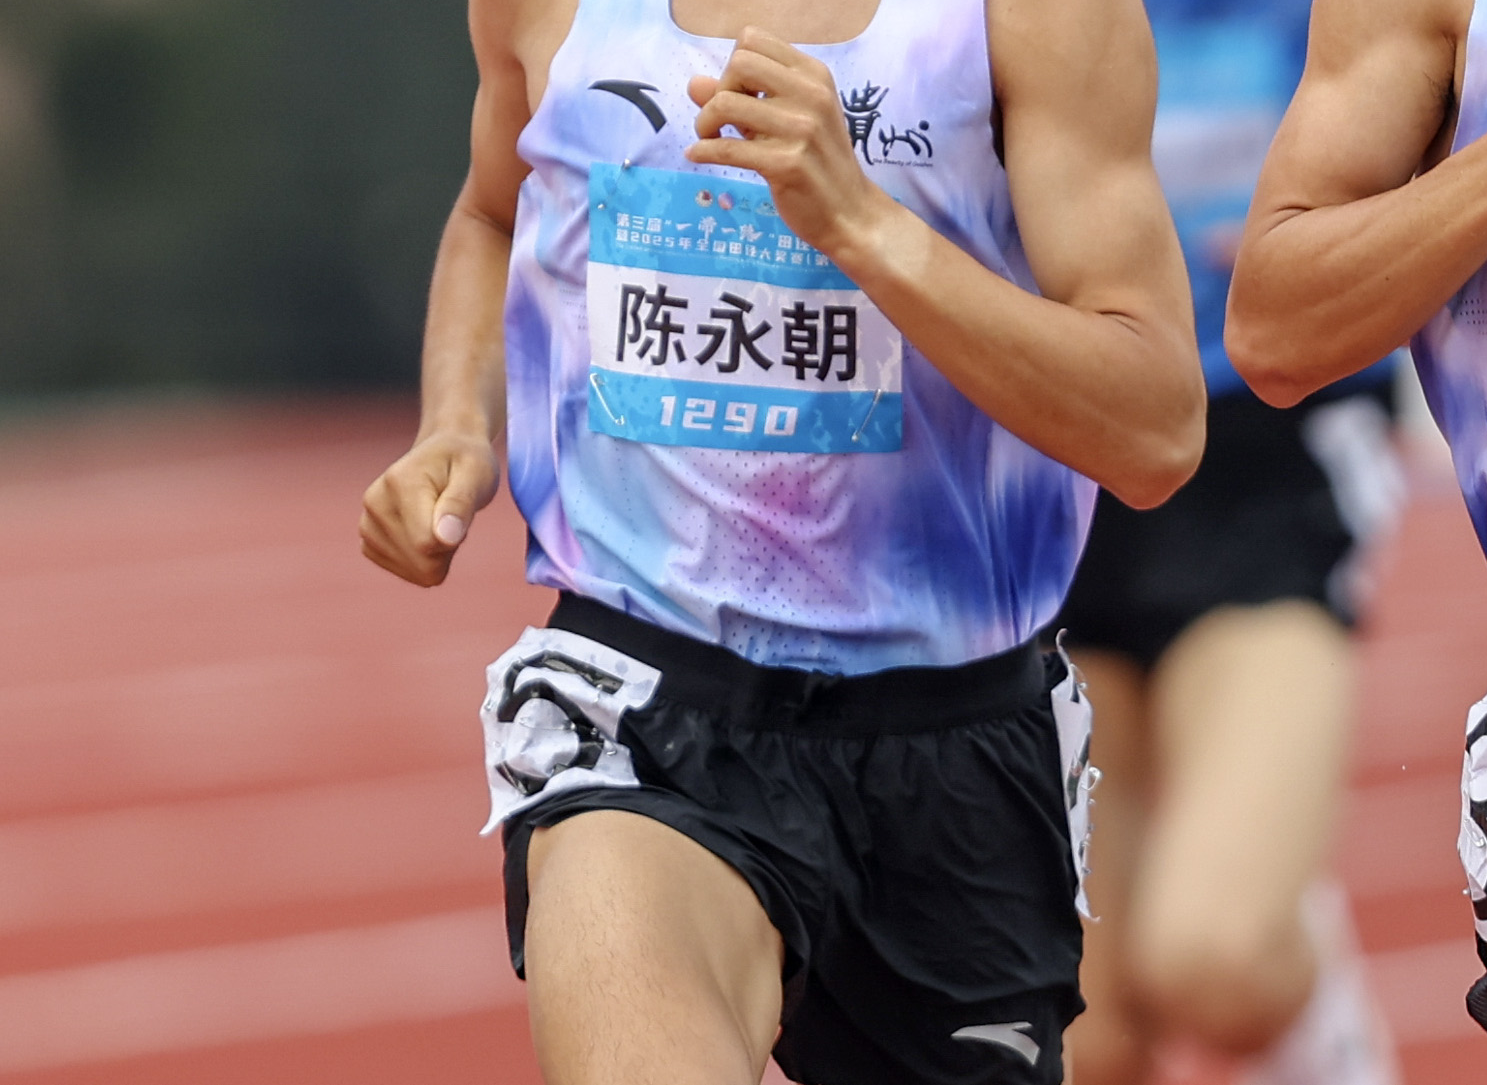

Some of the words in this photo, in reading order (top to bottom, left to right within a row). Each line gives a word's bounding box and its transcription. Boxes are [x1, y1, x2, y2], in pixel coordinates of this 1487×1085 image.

[614, 282, 858, 382] 陈永朝
[659, 394, 799, 437] 1290
